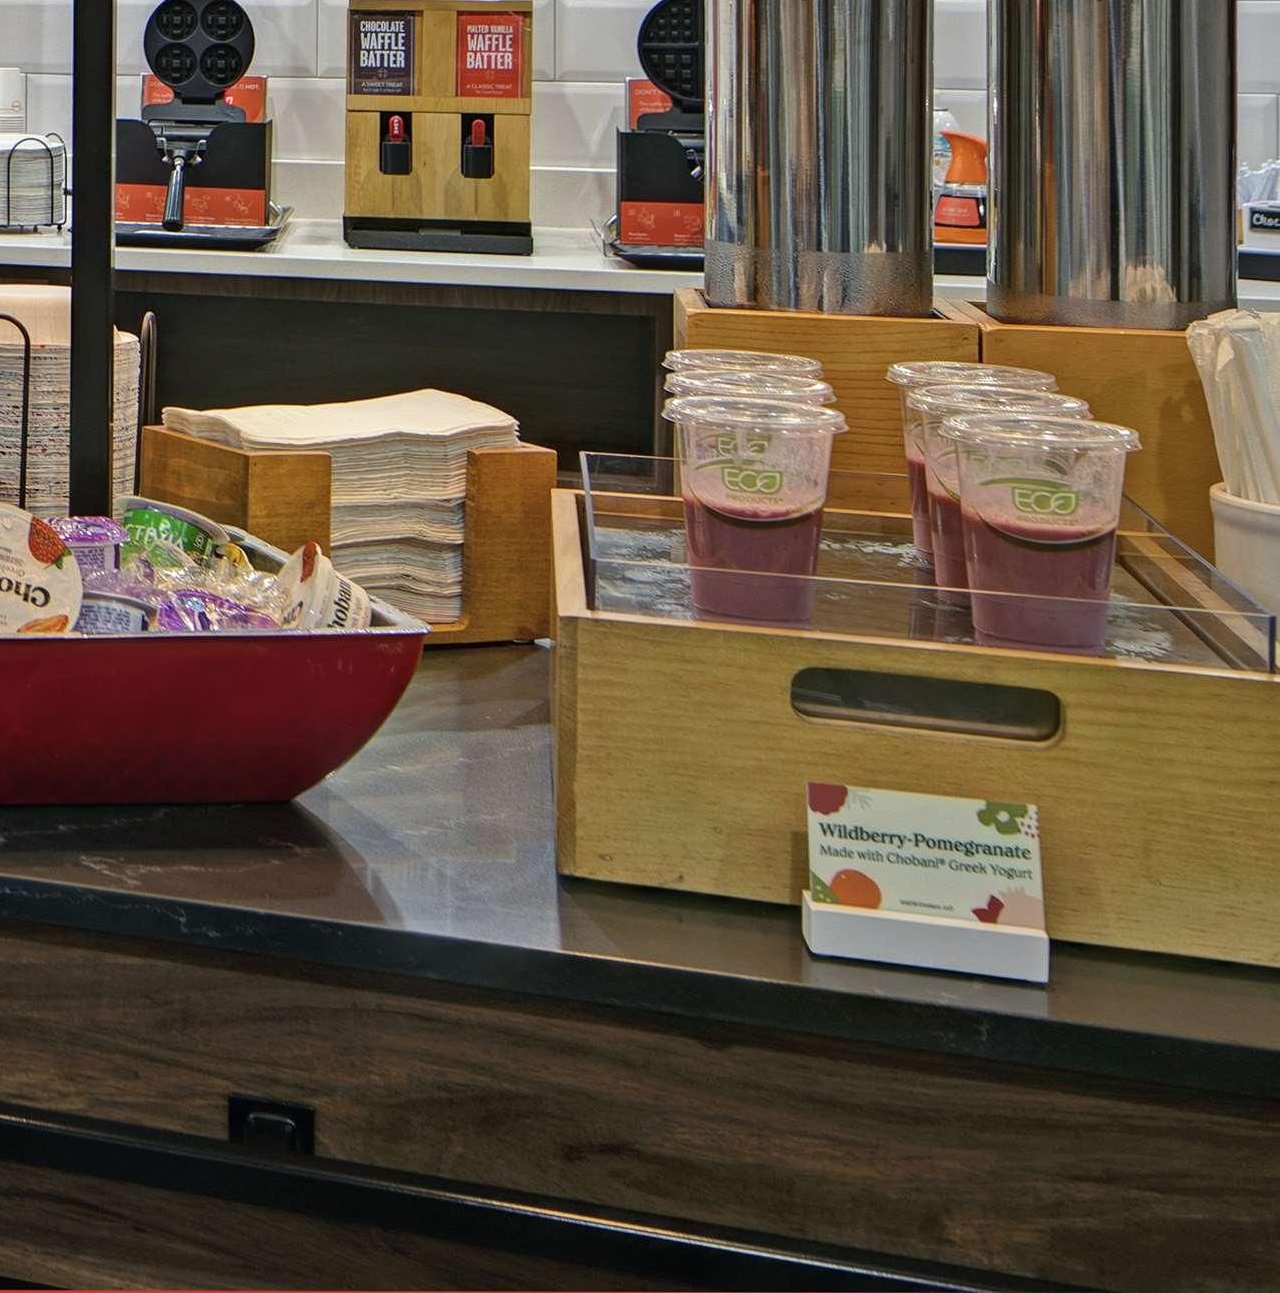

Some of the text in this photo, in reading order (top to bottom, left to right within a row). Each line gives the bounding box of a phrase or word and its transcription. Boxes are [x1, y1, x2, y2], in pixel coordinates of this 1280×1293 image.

[360, 20, 406, 32] CHOCOLATE
[360, 32, 406, 50] WAFFLE
[467, 34, 513, 52] WAFFLE
[359, 50, 406, 68] BATTER
[466, 52, 513, 70] BATTER
[723, 467, 781, 493] ECO
[1014, 488, 1077, 515] ECO
[818, 822, 1032, 860] Wildberry-Pomegranate
[820, 844, 855, 859] Made
[856, 850, 885, 864] with
[948, 860, 988, 875] Greek
[990, 863, 1034, 881] Yogurt
